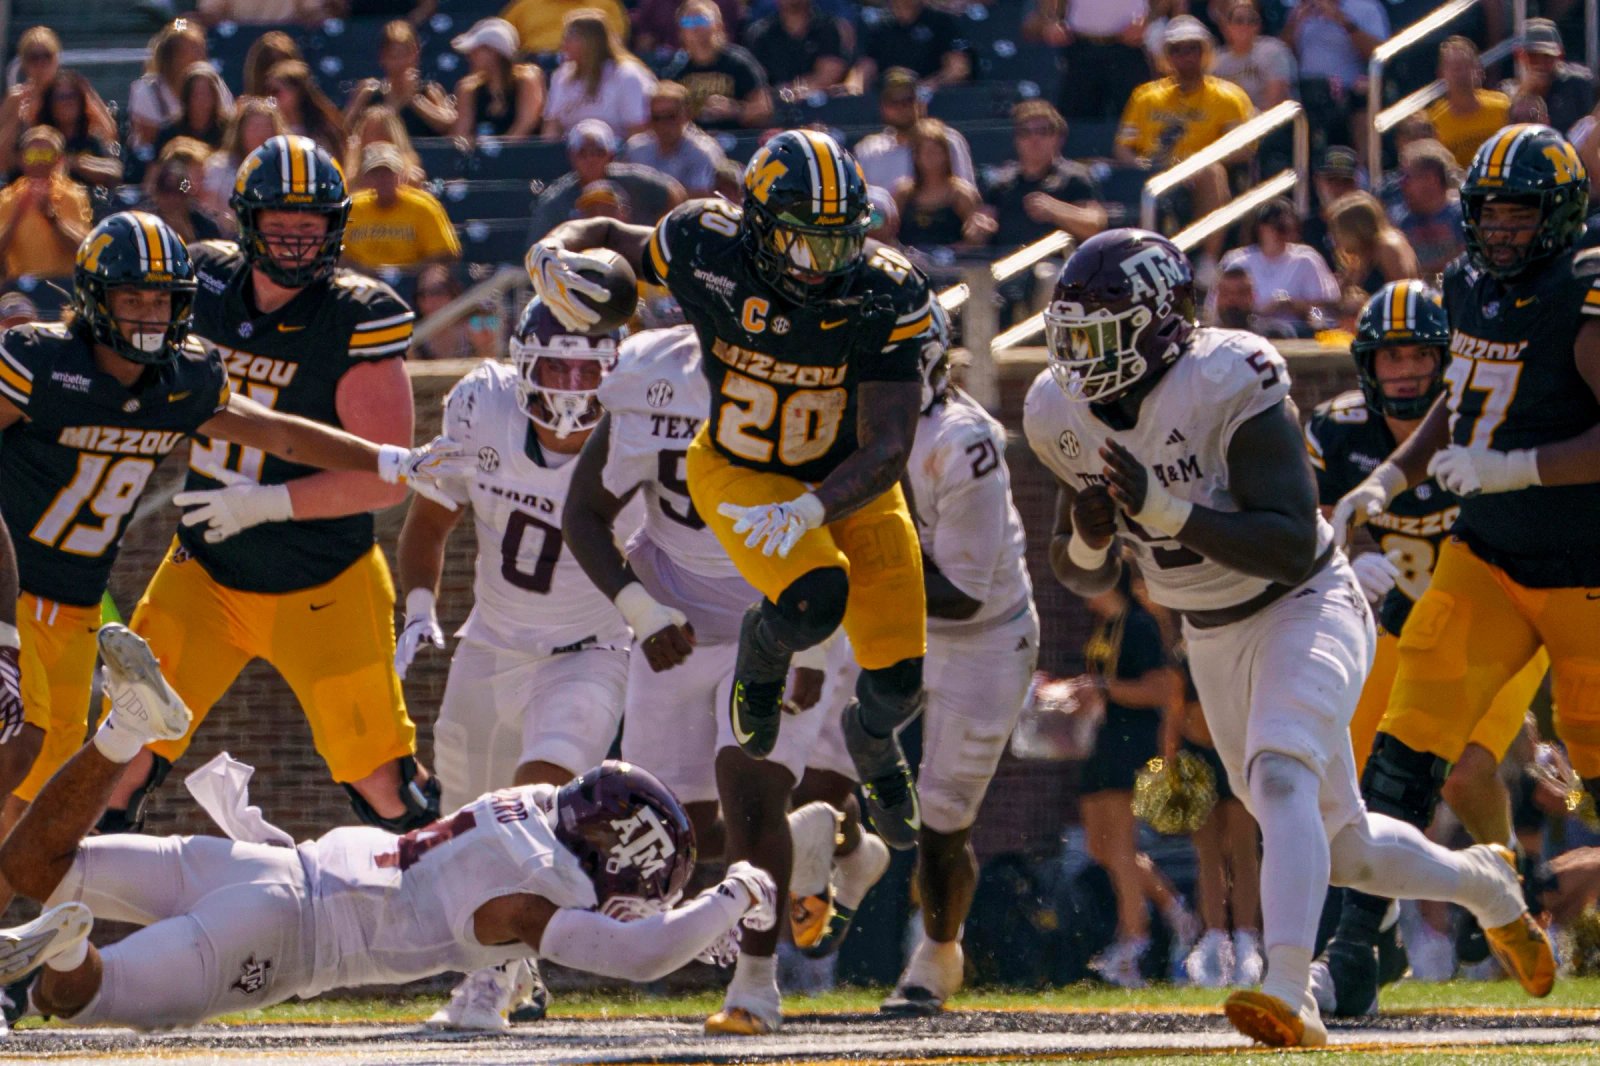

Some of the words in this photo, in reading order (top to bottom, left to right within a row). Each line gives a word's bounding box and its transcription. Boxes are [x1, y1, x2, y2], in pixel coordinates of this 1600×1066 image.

[693, 268, 737, 291] ambetter
[741, 295, 770, 335] C
[771, 314, 791, 335] SEC
[51, 370, 92, 387] ambetter
[216, 344, 299, 388] ZZOU
[711, 336, 849, 388] MIZZOU
[1245, 350, 1280, 391] 5
[647, 379, 674, 408] SEC
[1443, 352, 1525, 449] 77
[651, 414, 700, 440] TEX
[716, 369, 849, 468] 20
[58, 425, 186, 456] MIZZOU
[965, 437, 999, 480] 21
[1059, 430, 1081, 460] SEC
[477, 446, 500, 473] SEC
[29, 450, 157, 558] 19
[1367, 504, 1462, 538] MIZZO
[501, 508, 563, 595] 0
